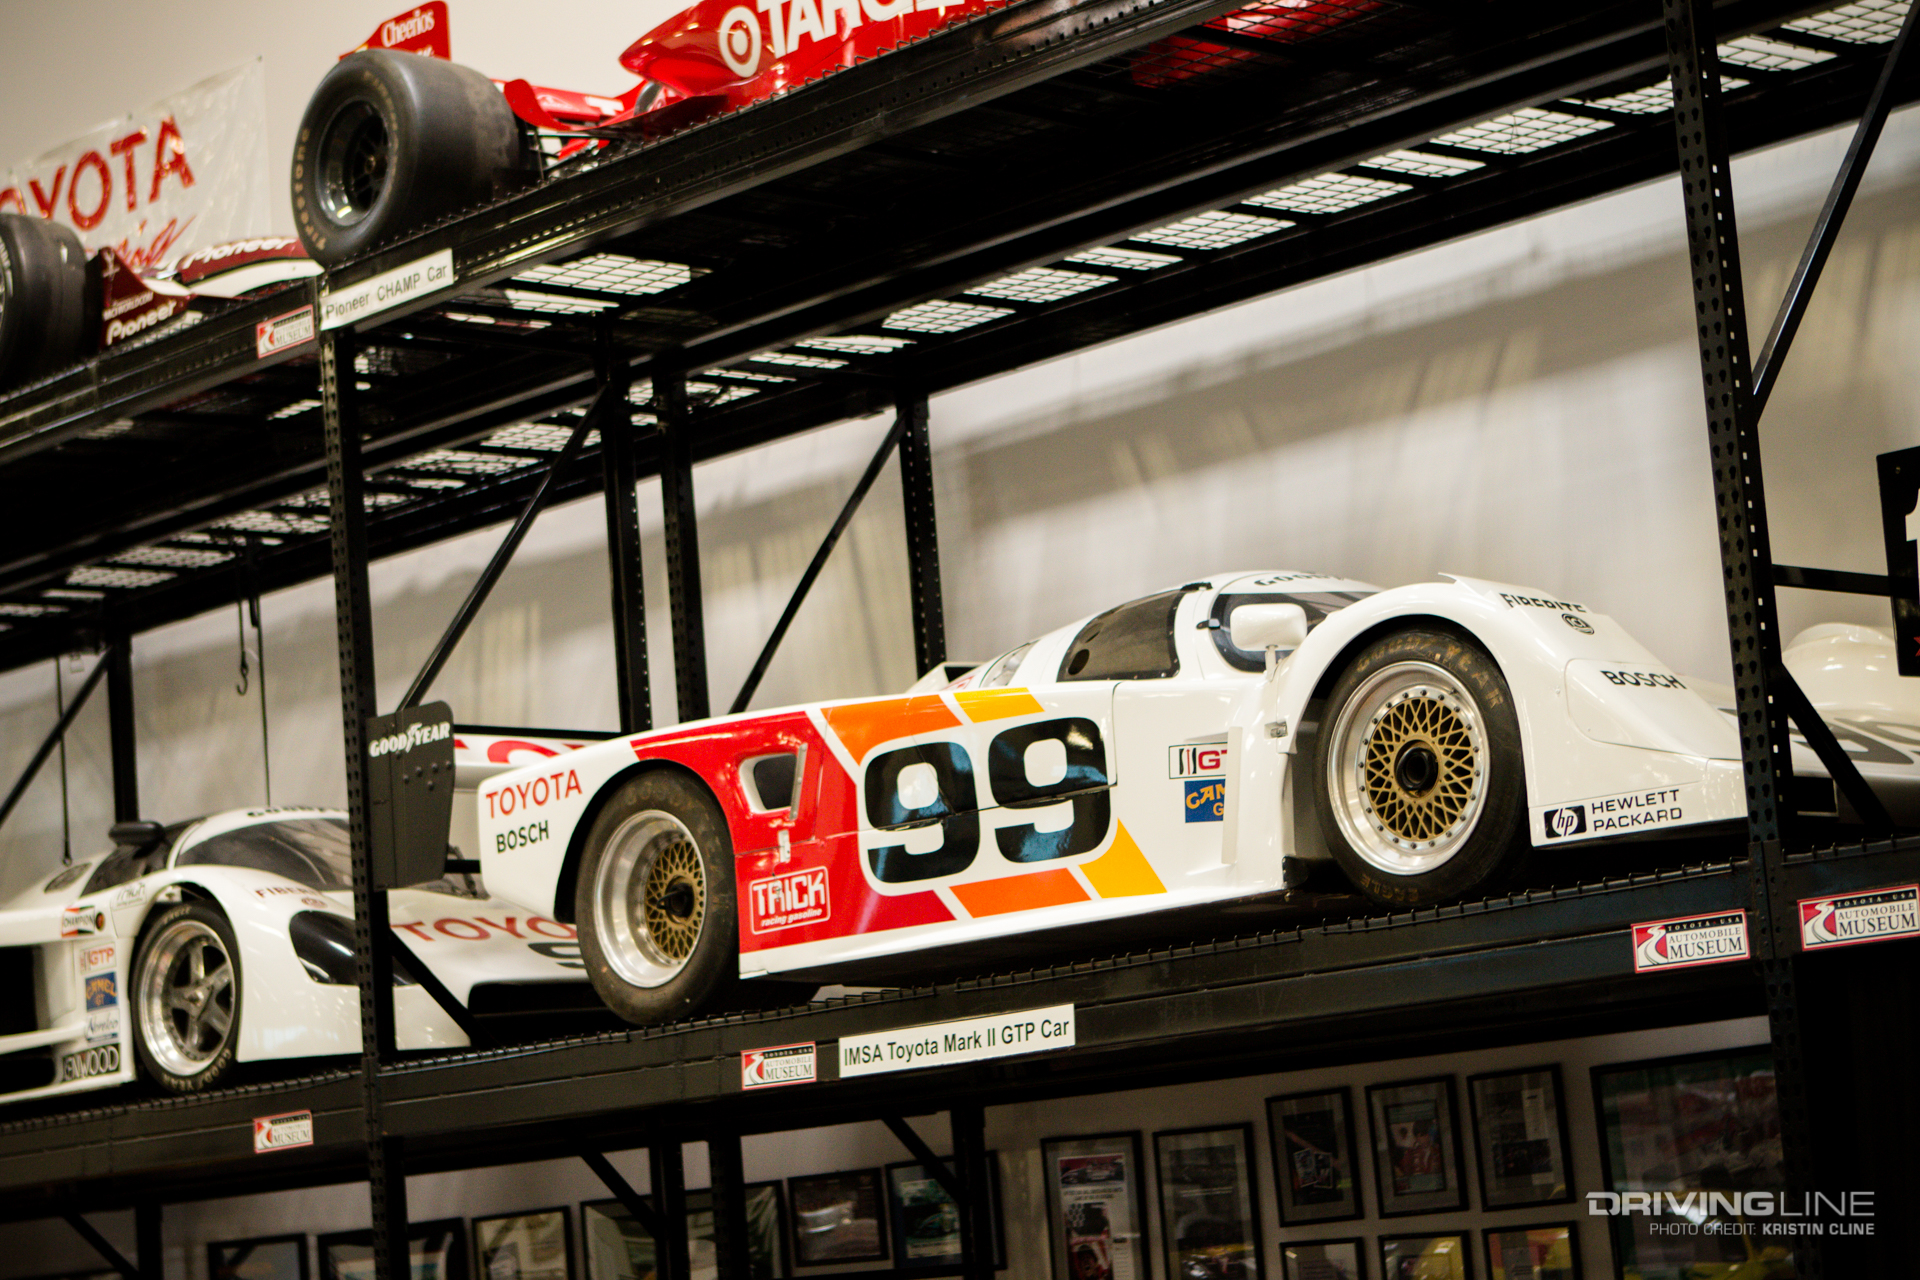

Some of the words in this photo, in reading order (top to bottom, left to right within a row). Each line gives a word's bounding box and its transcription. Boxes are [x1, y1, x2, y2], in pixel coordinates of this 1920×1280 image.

[381, 9, 435, 48] Cheerios
[182, 237, 297, 270] Pioneer
[326, 292, 370, 320] Pioneer
[377, 272, 421, 302] CHAMP
[427, 264, 448, 283] Car
[106, 299, 177, 346] Pioneer
[276, 324, 312, 346] MUSEUM
[1600, 670, 1688, 690] BOSCH
[369, 721, 452, 758] GOODYEAR
[485, 769, 583, 820] TOYOTA
[864, 716, 1111, 884] 99
[1591, 789, 1680, 815] HEWLETT
[1556, 808, 1576, 837] hp
[1593, 807, 1683, 832] PACKARD
[496, 820, 550, 854] BOSCH
[752, 872, 826, 916] TRICK
[1837, 896, 1882, 908] TOYOTA
[1892, 892, 1914, 900] USA
[761, 915, 787, 927] racing
[788, 908, 823, 923] gasoline
[1838, 902, 1915, 921] AUTOMOBILE
[1668, 921, 1711, 932] TOYOTA
[1720, 917, 1741, 925] USA
[1669, 926, 1742, 943] AUTOMOBILE
[1838, 913, 1916, 938] MUSEUM
[1670, 937, 1743, 960] MUSEUM
[844, 1044, 884, 1067] IMSA
[887, 1037, 939, 1063] Toyota
[944, 1030, 982, 1053] Mark
[987, 1028, 996, 1047] II
[1001, 1022, 1036, 1045] GTP
[1041, 1018, 1070, 1039] Car
[765, 1055, 813, 1068] AUTOMOBILE
[765, 1063, 813, 1080] MUSEUM
[273, 1129, 310, 1145] MUSEUM
